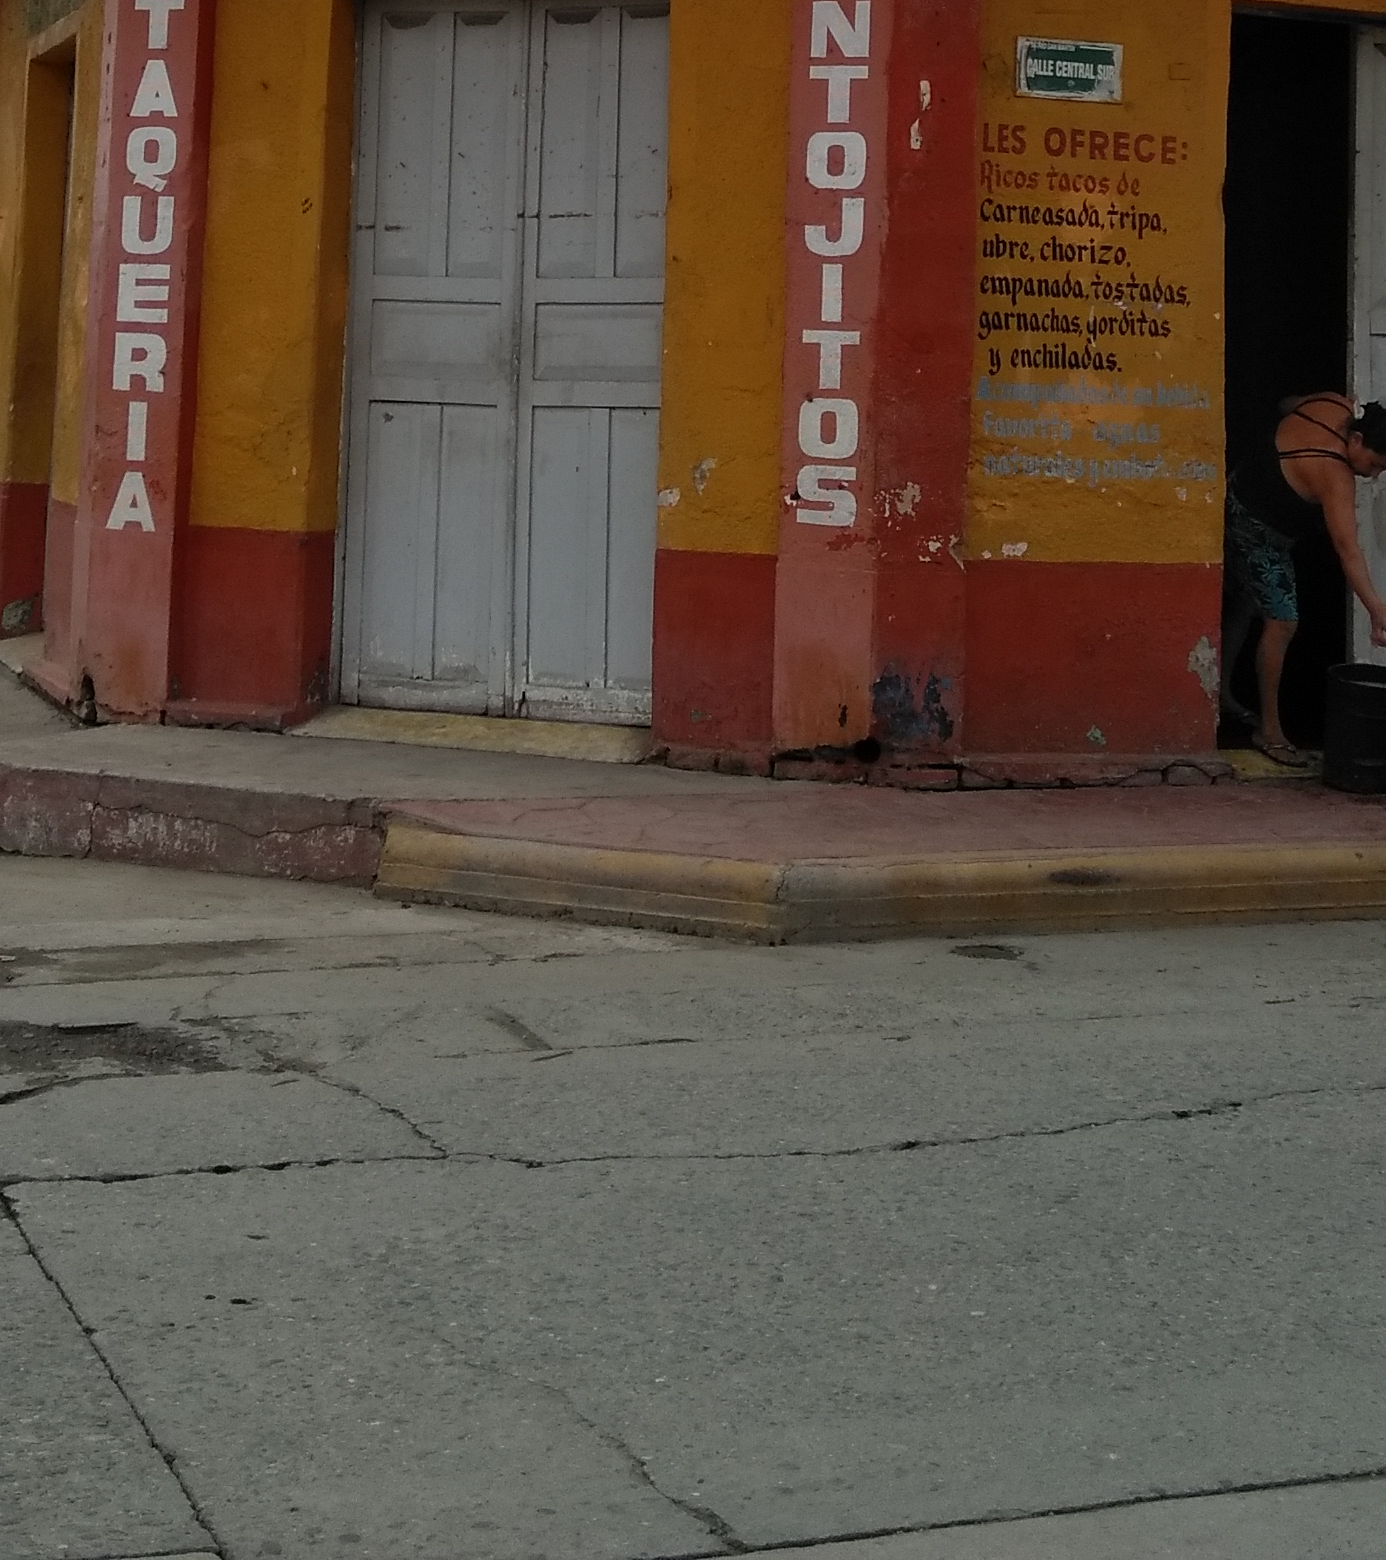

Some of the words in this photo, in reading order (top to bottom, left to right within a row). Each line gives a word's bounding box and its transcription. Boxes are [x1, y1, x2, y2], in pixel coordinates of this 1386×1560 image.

[1027, 59, 1054, 78] CALLE
[1056, 61, 1096, 80] CENTRAL
[1097, 64, 1115, 80] SUR
[982, 123, 1026, 154] LES
[1044, 127, 1188, 165] OFRECE:
[980, 159, 1040, 193] Ricos
[1046, 165, 1111, 195] tacos
[1116, 170, 1141, 197] de
[988, 347, 1001, 376] y
